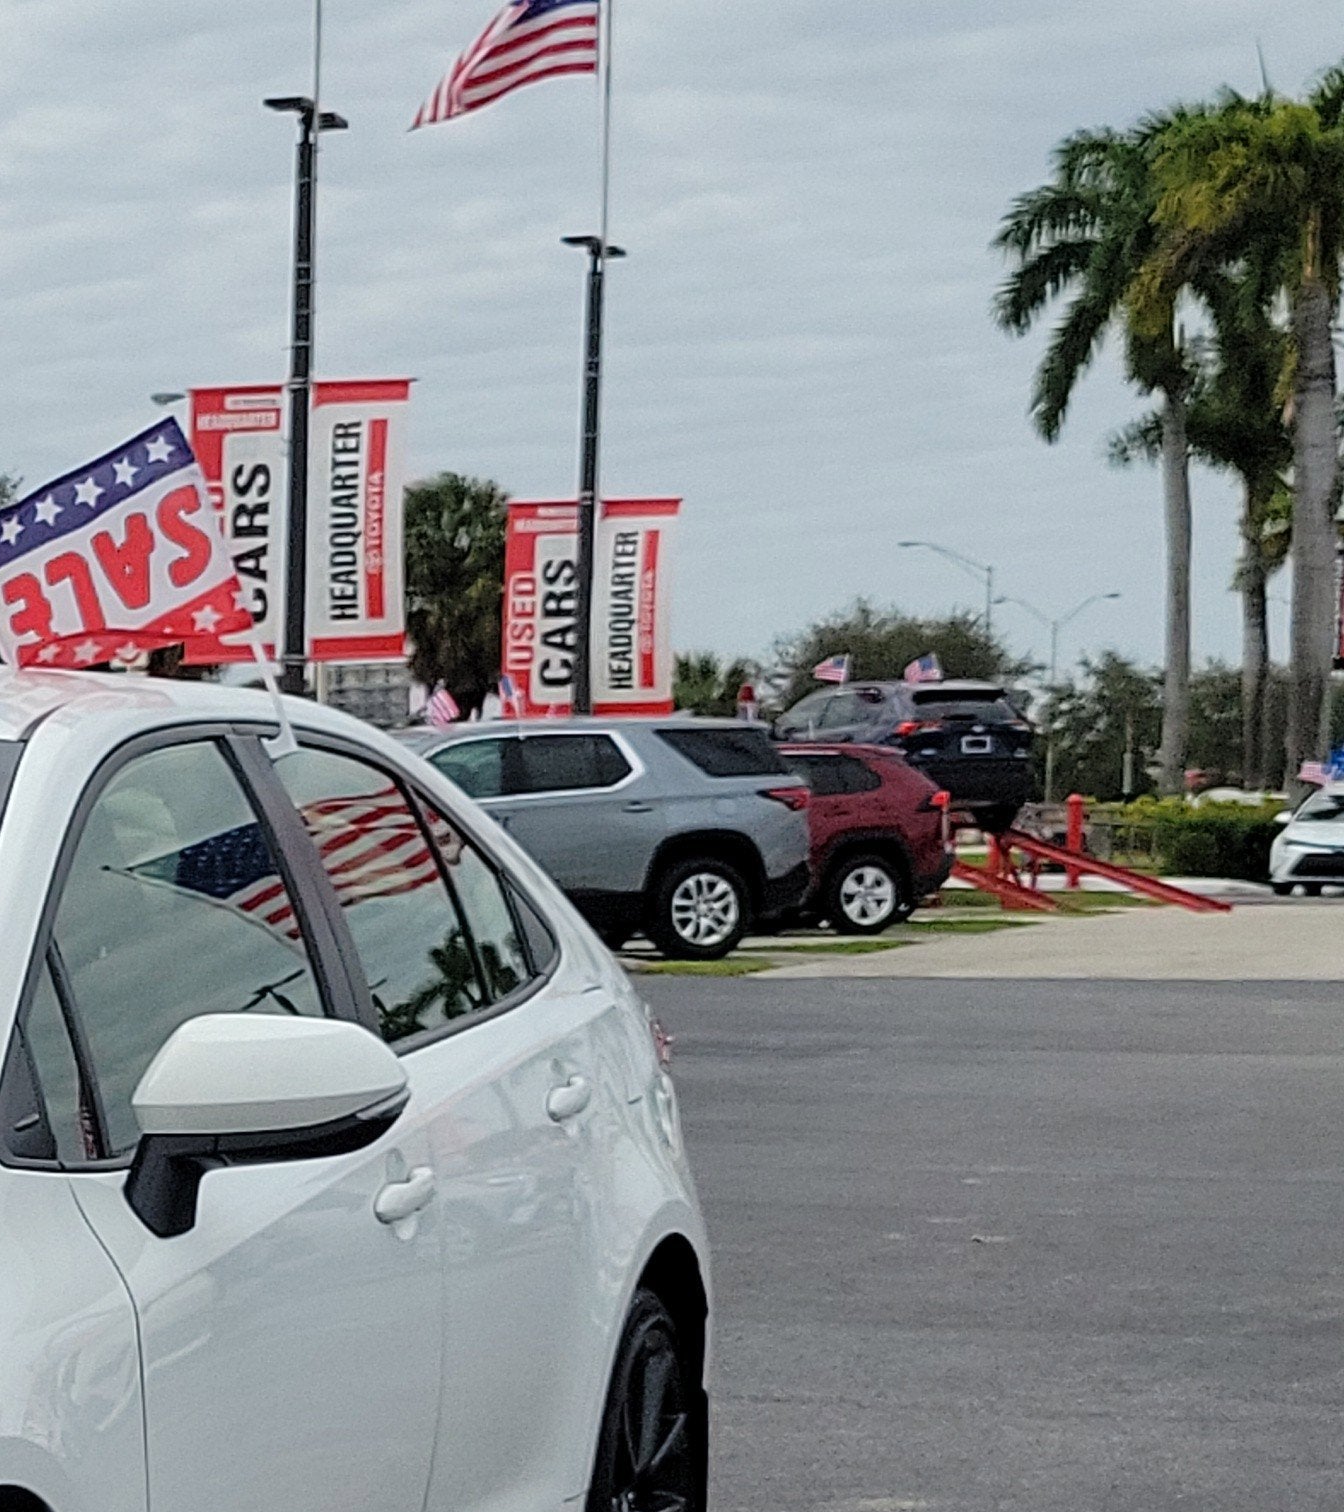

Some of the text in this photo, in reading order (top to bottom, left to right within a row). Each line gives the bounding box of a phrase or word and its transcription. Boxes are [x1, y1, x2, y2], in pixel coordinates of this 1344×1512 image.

[1, 484, 212, 641] SALE
[329, 420, 362, 621] HEADQUARTER
[508, 576, 536, 668] USED
[540, 559, 578, 688] CARS
[609, 530, 639, 690] HEADQUARTER
